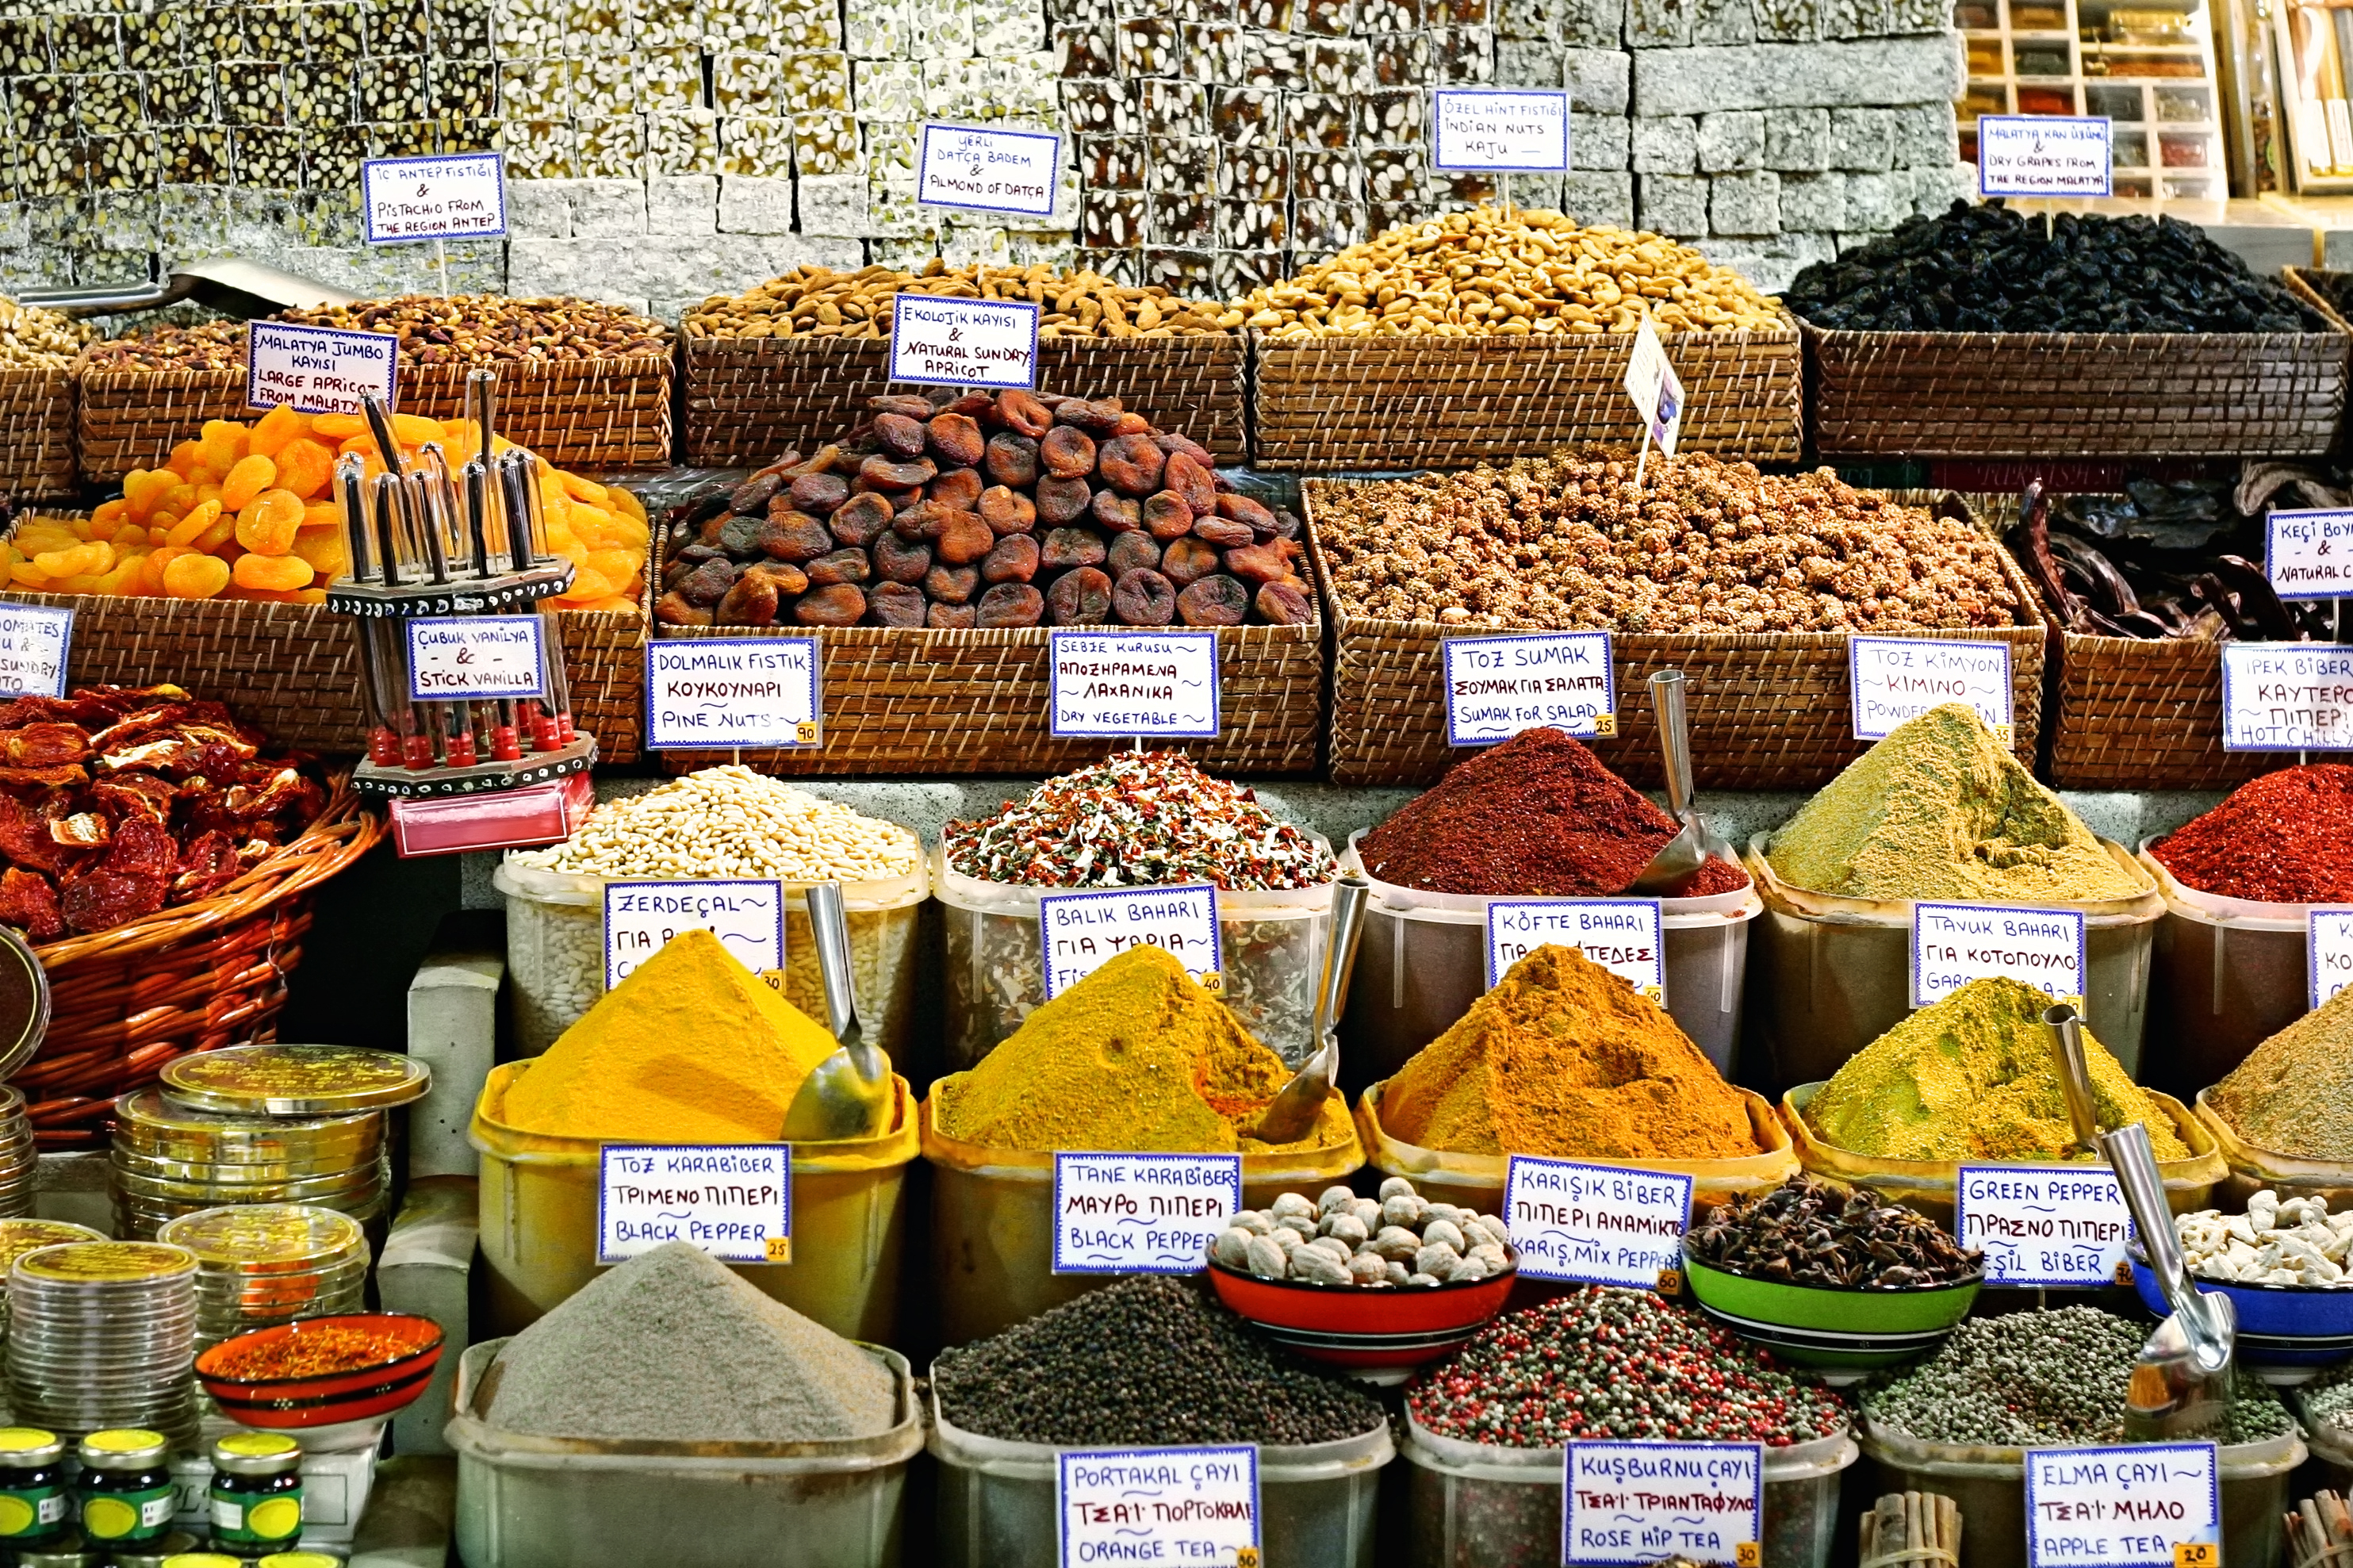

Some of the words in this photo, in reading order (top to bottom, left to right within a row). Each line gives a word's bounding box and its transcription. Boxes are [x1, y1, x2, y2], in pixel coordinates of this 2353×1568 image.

[1445, 98, 1480, 115] ÖZEL
[1505, 124, 1544, 135] NUTS
[1989, 128, 2041, 145] MALATYA
[1465, 140, 1508, 160] KAJU
[2032, 141, 2045, 155] &
[987, 151, 1031, 168] BADEM
[1989, 155, 2012, 167] DRY
[2066, 157, 2096, 170] FROM
[398, 166, 443, 180] ANTEP
[969, 163, 984, 177] &
[929, 174, 983, 194] ALMOND
[987, 182, 1002, 195] OF
[1988, 174, 2009, 184] THE
[2056, 174, 2104, 186] MALATYA
[416, 183, 431, 198] &
[447, 198, 485, 213] FROM
[376, 222, 400, 235] THE
[452, 212, 496, 229] ANTEP
[948, 327, 964, 343] &
[257, 334, 328, 355] MALATYA
[331, 341, 384, 360] JUMBO
[901, 340, 970, 359] NATURAL
[291, 354, 336, 373] KAYISI
[258, 368, 306, 391] LARGE
[257, 386, 296, 408] FROM
[300, 390, 361, 414] MALATY
[2317, 539, 2332, 557] &
[2276, 564, 2340, 583] NATURAL
[417, 630, 468, 654] ÇUBUK
[1060, 639, 1108, 654] SEBZE
[1116, 642, 1173, 654] KURUSU
[456, 646, 475, 665] &
[659, 654, 743, 671] DOLMALIK
[748, 653, 807, 671] FISTIK
[1461, 650, 1505, 669] TOZ
[1515, 645, 1590, 666] SUMAK
[1869, 649, 1914, 668] TOZ
[661, 711, 709, 728] PINE
[717, 712, 770, 728] NUTS
[1061, 709, 1085, 723] DRY
[1092, 711, 1178, 726] VEGETABLE
[1459, 706, 1512, 724] SUMAK
[1515, 705, 1543, 723] FOR
[1546, 703, 1600, 723] SALAD
[798, 725, 814, 739] 90
[1596, 717, 1611, 732] 25
[1997, 727, 2010, 741] 35
[2240, 721, 2287, 746] HOT
[617, 893, 741, 919] ZERDEÇAL
[1056, 907, 1117, 926] BALIK
[1127, 900, 1199, 922] BAHARI
[1502, 911, 1570, 932] KÖFTE
[1579, 913, 1644, 933] BAHARI
[1926, 915, 1994, 935] TAVUK
[2002, 920, 2069, 943] BAHARI
[1204, 977, 1221, 990] 40
[613, 1156, 655, 1175] TOZ
[1067, 1164, 1126, 1184] TANE
[1969, 1179, 2039, 1201] GREEN
[2048, 1181, 2121, 1206] PEPPER
[615, 1220, 680, 1244] BLACK
[689, 1220, 768, 1244] PEPPER
[1071, 1227, 1135, 1250] BLACK
[768, 1242, 786, 1256] 25
[1659, 1275, 1677, 1288] 60
[1074, 1466, 1182, 1489] PORTAKAL
[1190, 1463, 1239, 1491] ÇAYI
[1581, 1456, 1703, 1485] KUŞBURNU
[1707, 1459, 1752, 1489] ÇAYI
[2043, 1463, 2109, 1486] ELMA
[2116, 1463, 2167, 1491] ÇAYI
[1581, 1528, 1632, 1548] ROSE
[1678, 1531, 1721, 1551] TEA
[2044, 1536, 2109, 1557] APPLE
[2119, 1534, 2167, 1555] TEA
[1079, 1540, 1164, 1563] ORANGE
[1174, 1539, 1216, 1559] TEA
[1738, 1548, 1756, 1562] 30
[2184, 1546, 2208, 1562] 20
